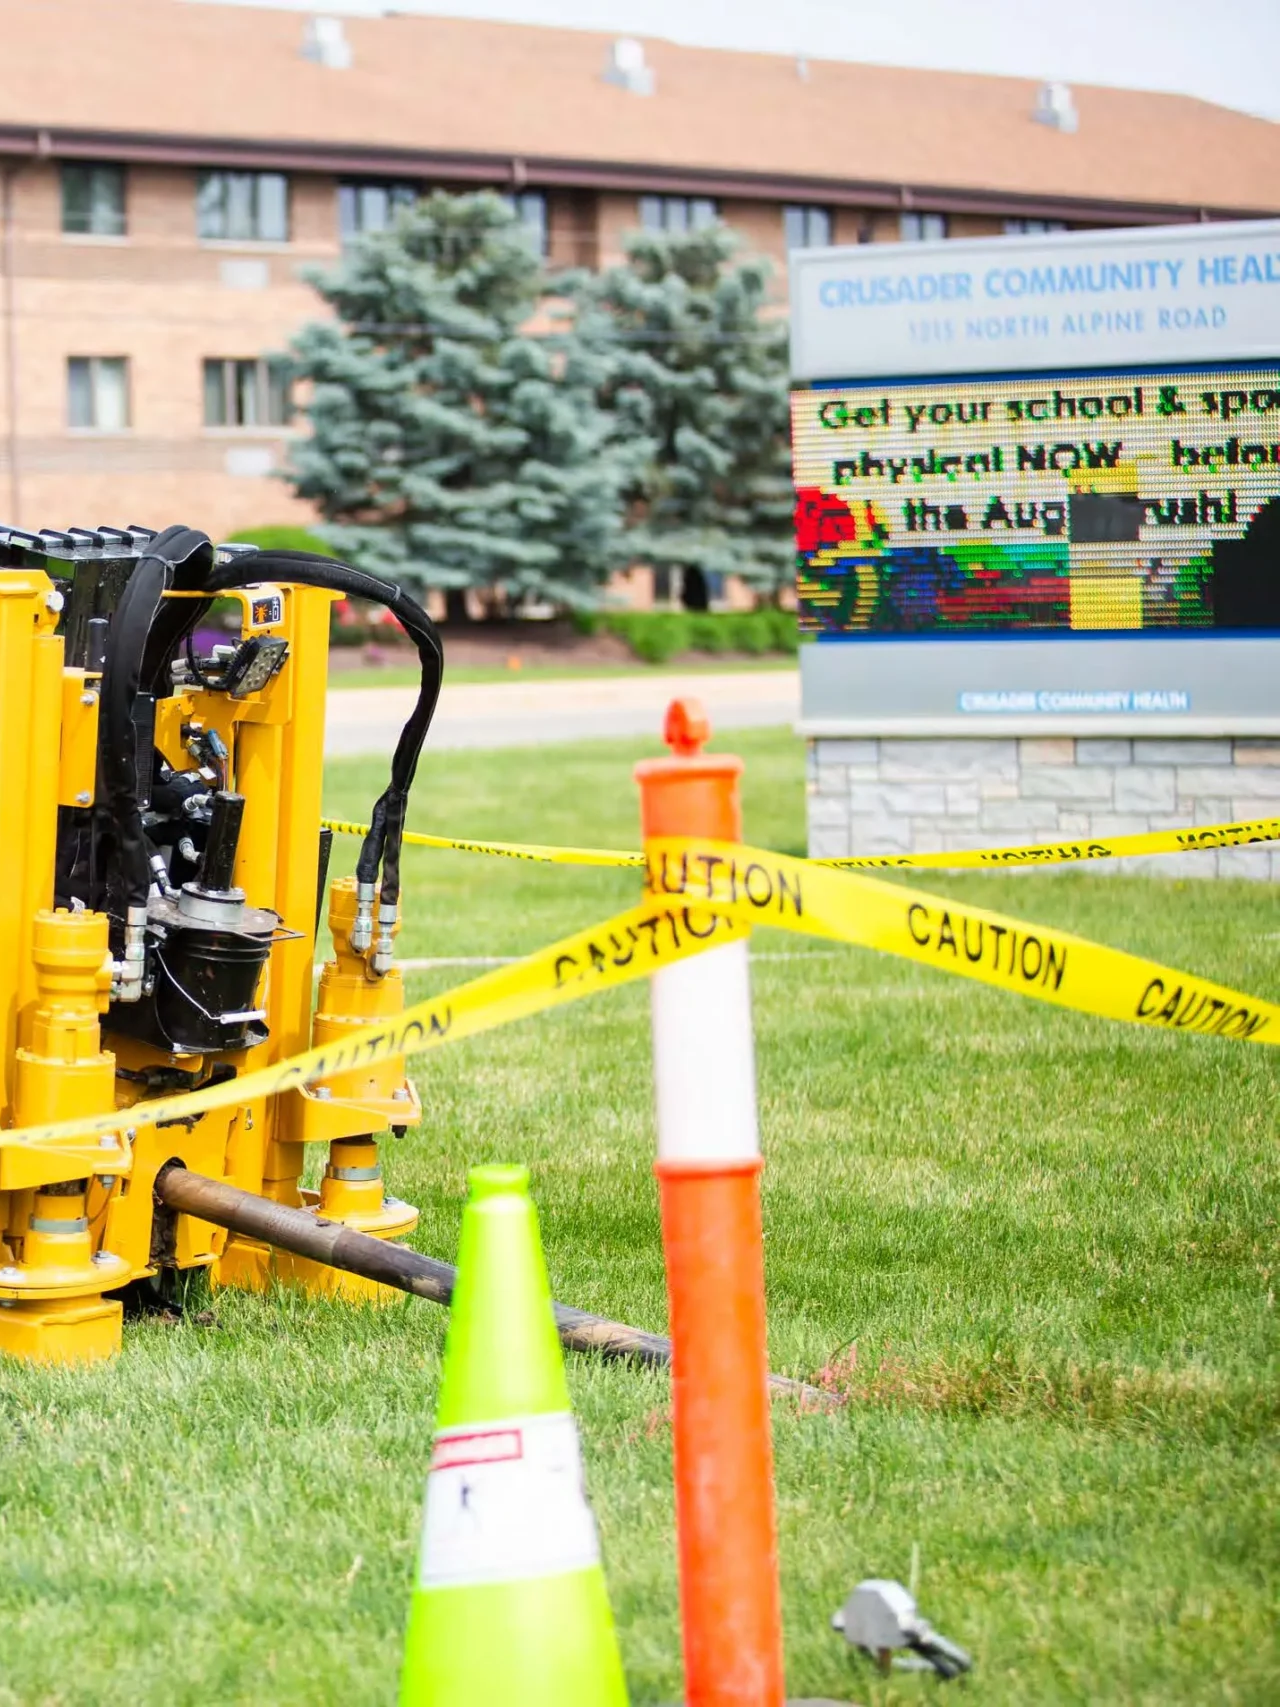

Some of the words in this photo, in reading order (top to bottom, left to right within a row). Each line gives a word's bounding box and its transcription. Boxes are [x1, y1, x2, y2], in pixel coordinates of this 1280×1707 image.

[819, 272, 972, 308] CRUSADER
[984, 259, 1183, 298] COMMUNITY
[1198, 252, 1280, 286] HEAL
[965, 314, 1049, 340] NORTH
[1062, 307, 1144, 335] ALPINE
[1158, 304, 1226, 330] ROAD
[820, 398, 888, 428] Get
[904, 401, 990, 432] your
[1005, 387, 1143, 420] school
[1157, 386, 1186, 415] &
[1016, 441, 1122, 476] NOW
[982, 494, 1067, 536] Aug
[554, 907, 734, 989] CAUTIO
[645, 852, 804, 918] AUTION
[907, 903, 1068, 991] CAUTION
[1135, 978, 1271, 1037] CAUTION
